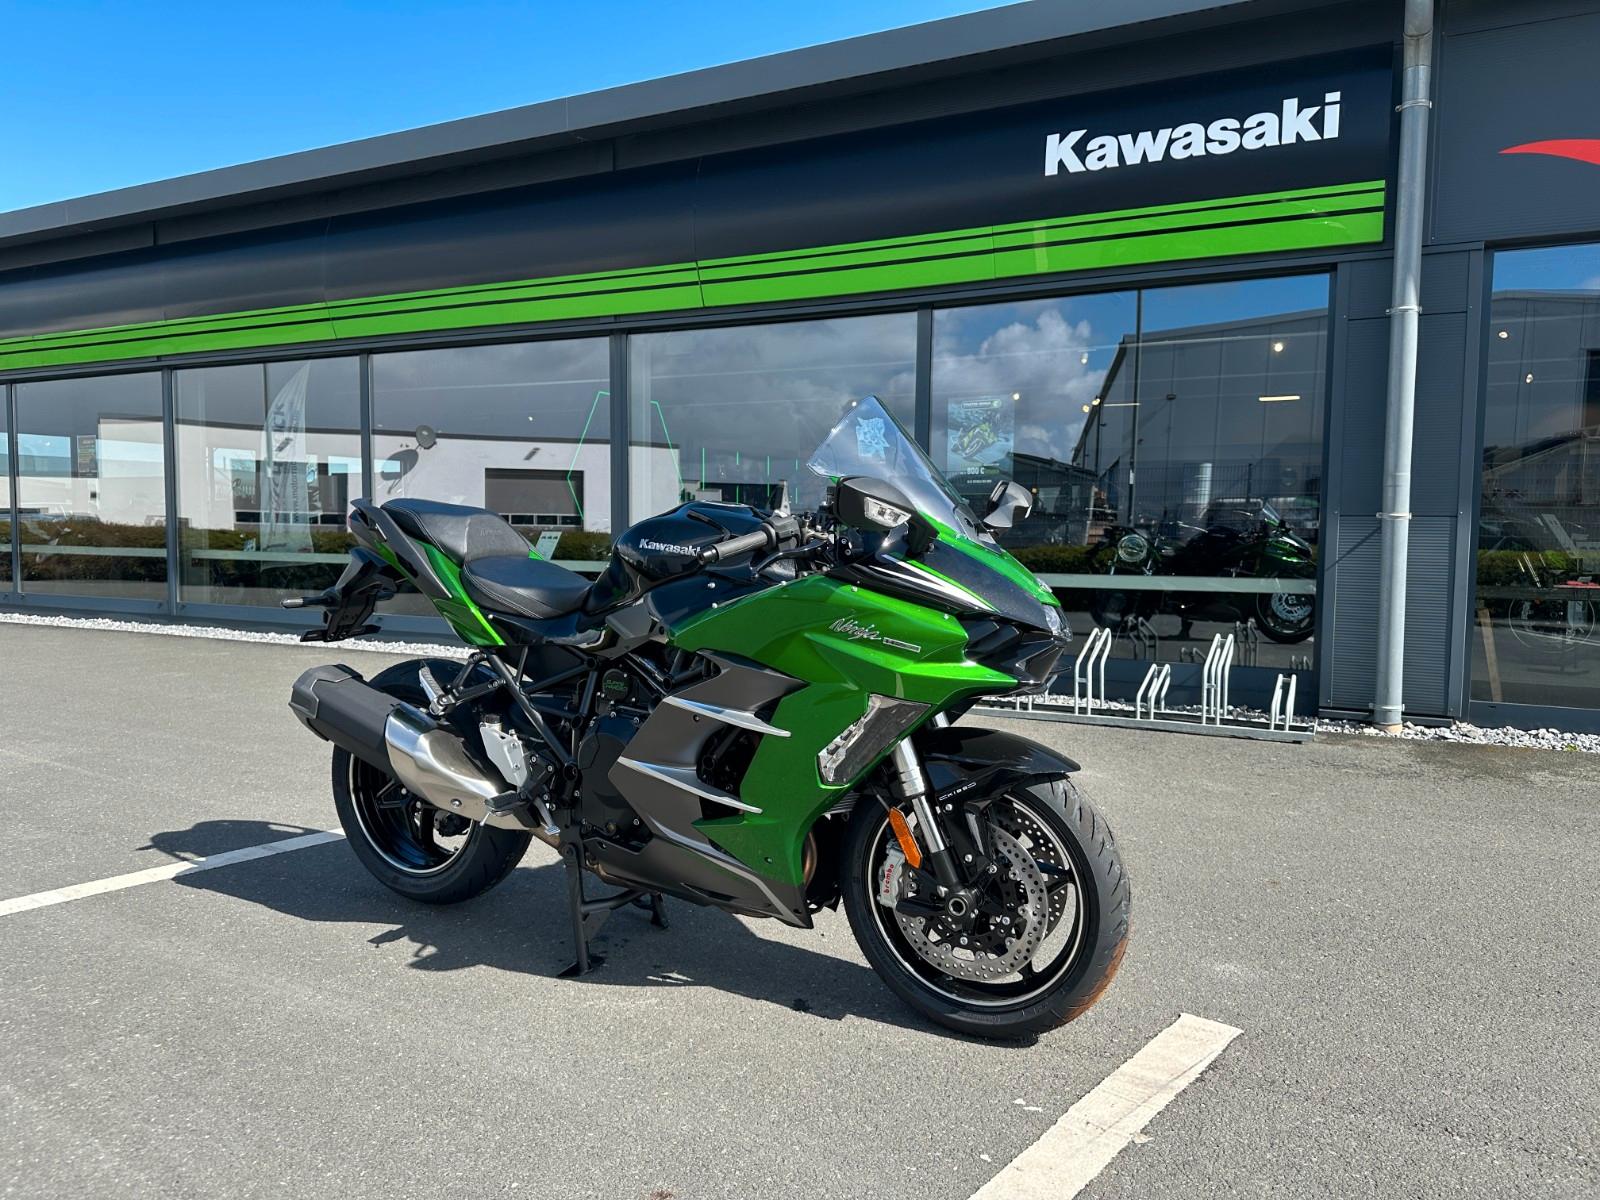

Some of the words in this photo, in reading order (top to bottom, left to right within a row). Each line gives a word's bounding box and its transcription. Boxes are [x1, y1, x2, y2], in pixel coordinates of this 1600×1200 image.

[1045, 91, 1341, 176] Kawasaki
[829, 618, 881, 640] Ninja
[883, 863, 894, 894] brembo
